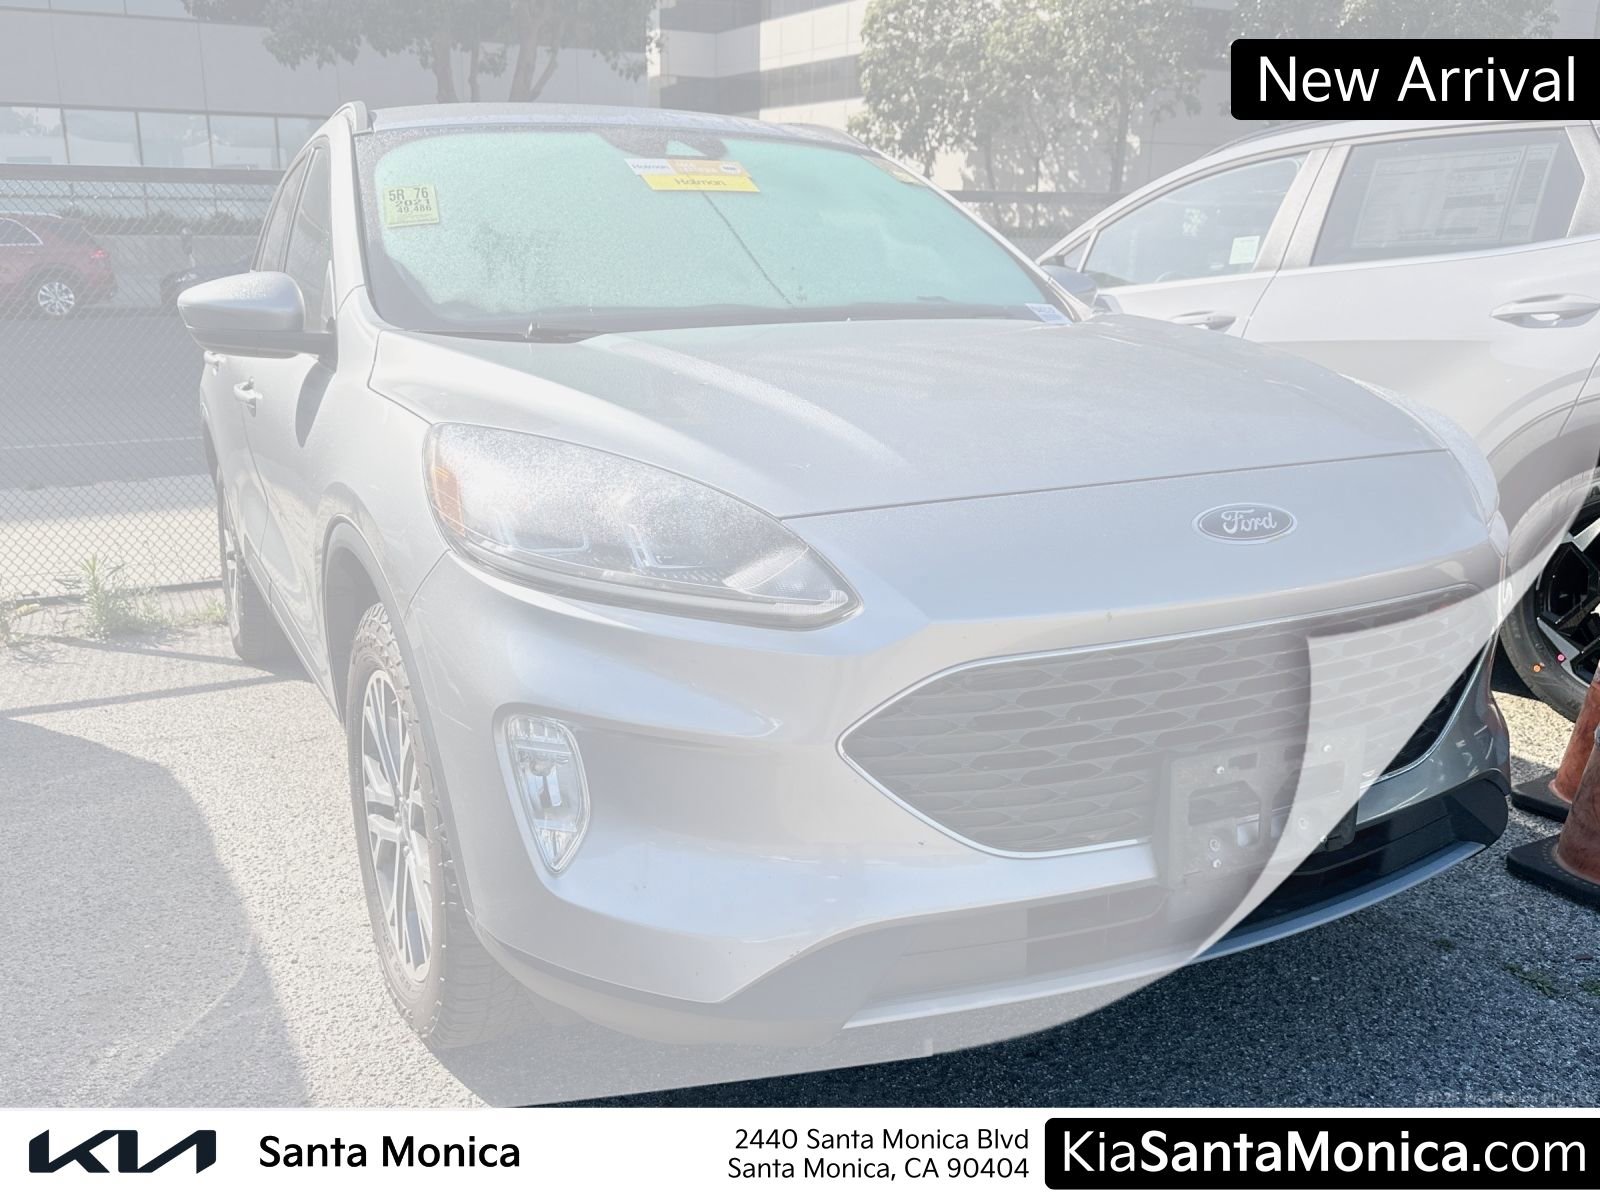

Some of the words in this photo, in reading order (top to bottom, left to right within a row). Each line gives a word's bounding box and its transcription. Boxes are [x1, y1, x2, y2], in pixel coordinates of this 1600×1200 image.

[388, 189, 405, 202] 5R
[413, 187, 429, 199] 76
[395, 198, 431, 208] 2021
[1221, 508, 1277, 534] Ford
